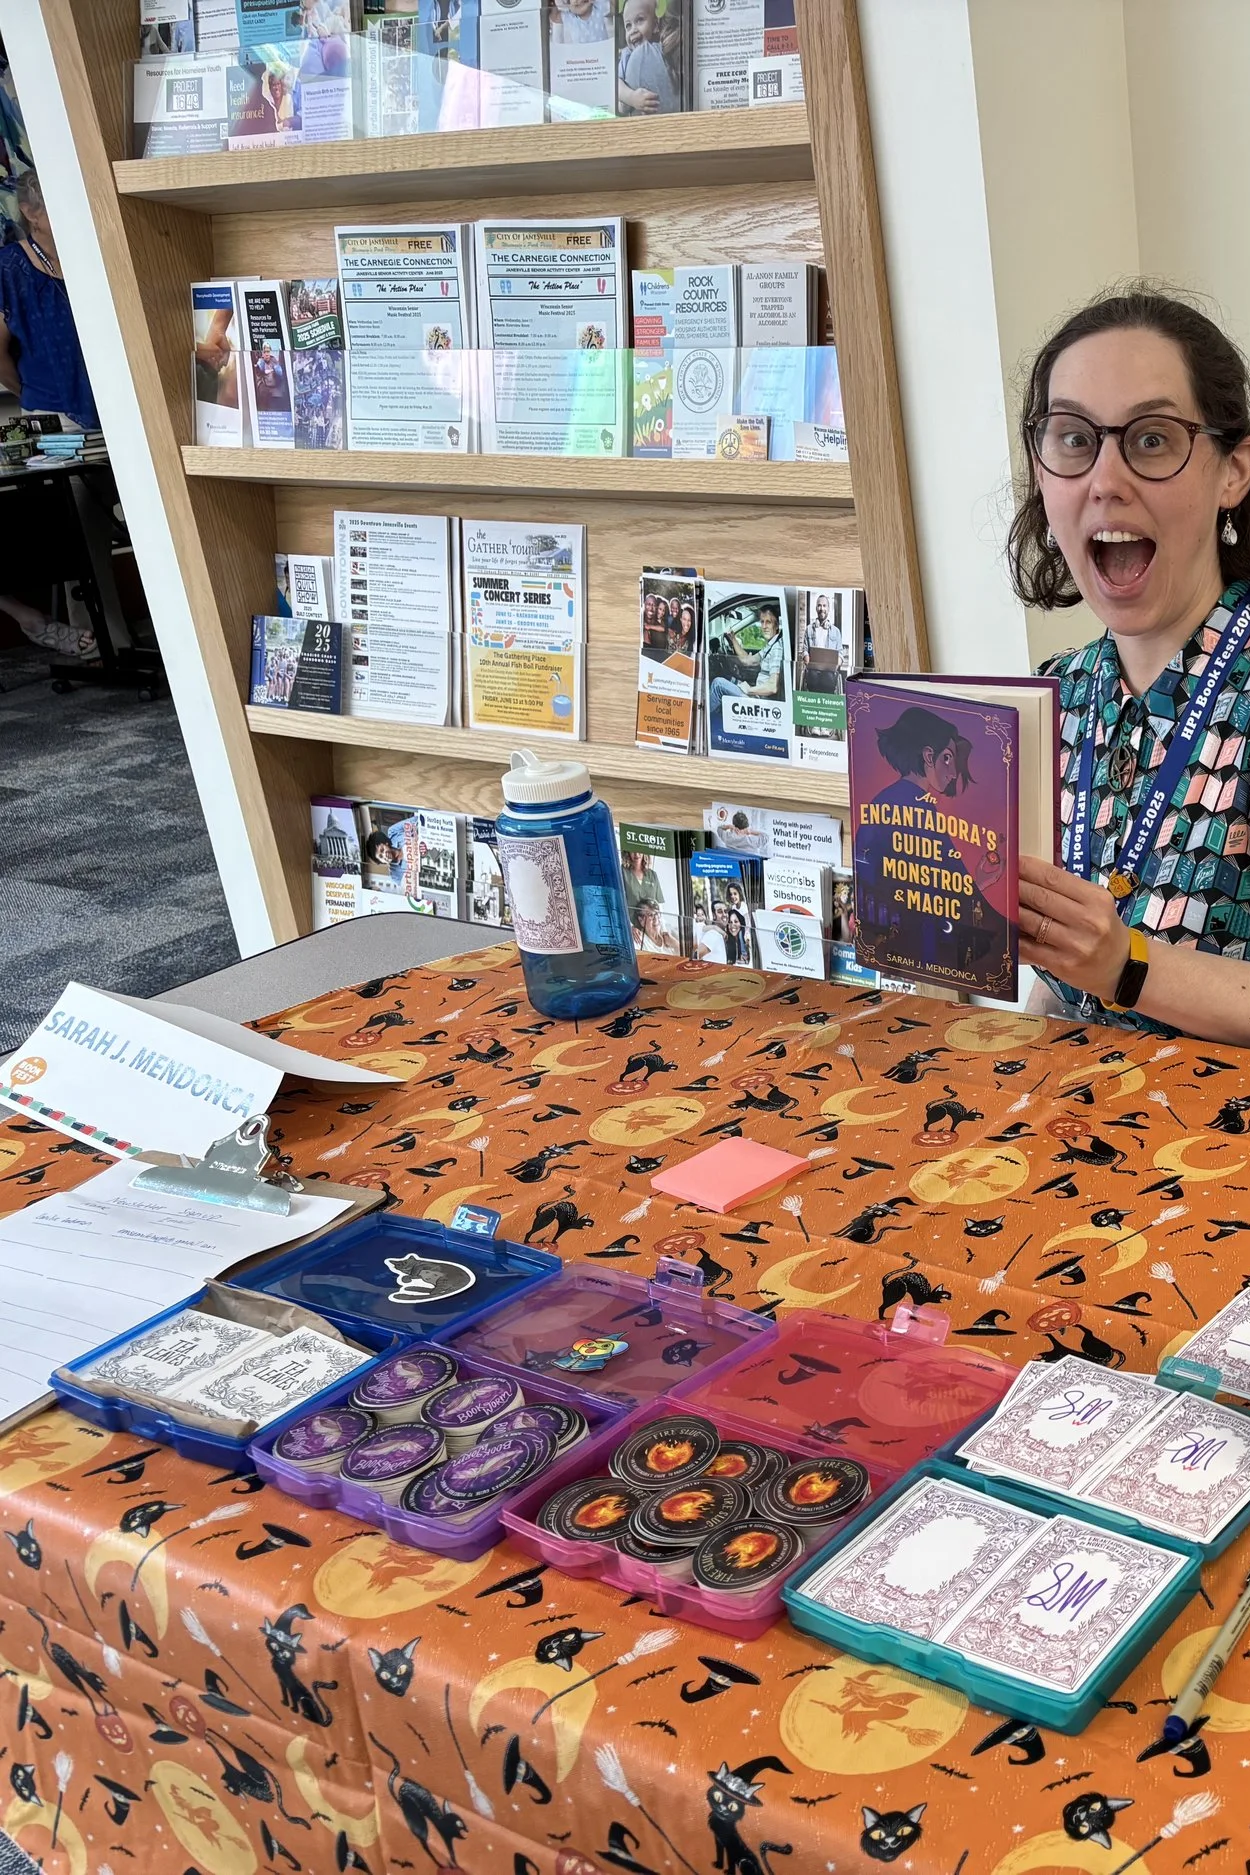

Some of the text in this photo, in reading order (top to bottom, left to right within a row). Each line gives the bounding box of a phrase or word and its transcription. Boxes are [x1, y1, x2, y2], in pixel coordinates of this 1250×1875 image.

[145, 69, 173, 77] Resources
[182, 67, 206, 75] Homeless
[173, 80, 198, 93] PROJECT
[229, 80, 245, 91] Need
[230, 93, 249, 106] health
[230, 104, 265, 120] insurance?
[408, 240, 432, 250] FREE
[566, 236, 592, 245] FREE
[344, 257, 453, 266] THE CARNEGIE CONNECTION
[491, 253, 611, 263] THE CARNEGIE CONNECTION
[688, 276, 713, 287] ROCK
[746, 272, 798, 280] AL-ANON FAMILY
[376, 284, 387, 293] The
[528, 281, 540, 290] The
[683, 289, 719, 300] COUNTY
[675, 301, 727, 313] RESOURCES
[297, 331, 310, 342] 2025
[309, 321, 335, 338] SCHEDULE
[477, 529, 486, 539] the
[468, 537, 508, 554] GATHER
[339, 534, 347, 618] DOWNTOWN
[297, 581, 315, 590] QUILT
[473, 577, 509, 590] SUMMER
[298, 592, 316, 601] SHOW
[484, 590, 551, 605] CONCERT SERIES
[315, 624, 331, 638] 20
[315, 638, 330, 652] 25
[504, 653, 531, 662] Gathering
[492, 660, 510, 668] Annual
[511, 661, 523, 669] Fish
[523, 662, 534, 670] Boil
[534, 663, 563, 672] Fundraiser
[1181, 706, 1203, 741] HPL
[1197, 670, 1220, 710] Book
[1214, 636, 1238, 674] Fest
[647, 694, 671, 706] Serving
[822, 698, 844, 706] Telework
[656, 706, 671, 715] local
[644, 715, 684, 727] communities
[1085, 705, 1096, 739] 2025
[665, 728, 680, 736] 1965
[915, 792, 938, 805] An
[773, 819, 787, 828] Living
[860, 803, 997, 851] ENCANTADORA'S
[1129, 789, 1166, 862] Fest 2025
[626, 832, 666, 845] ST. CROIX
[773, 828, 792, 838] What
[813, 835, 833, 843] could
[773, 838, 811, 851] feel better?
[892, 831, 962, 862] GUIDE to
[404, 823, 414, 897] Participating
[767, 874, 816, 888] wisconsibs
[883, 857, 974, 896] MONSTROS
[325, 882, 354, 890] WISCONSIN
[326, 891, 350, 899] DESERVES
[773, 889, 812, 904] Sibshops
[325, 899, 355, 908] PERMANENT
[894, 889, 961, 921] & MAGIC
[845, 961, 862, 972] Kids
[886, 953, 978, 983] SARAH J. MENDONCA
[18, 1061, 42, 1076] BOOK
[44, 1010, 256, 1118] SARAH J. MENDONCA
[12, 1069, 35, 1083] FEST
[169, 1339, 199, 1354] TEA
[142, 1346, 192, 1367] LEAVES
[279, 1360, 308, 1378] TEA
[253, 1366, 300, 1391] LEAVES
[456, 1390, 513, 1423] BOOK WORM
[653, 1429, 701, 1440] FIRE SLUG
[483, 1440, 512, 1458] BOOK
[352, 1459, 412, 1476] BOOK WORM
[841, 1465, 859, 1477] SLUG
[626, 1486, 647, 1499] FIRE
[706, 1493, 734, 1528] FIRE SLUG
[702, 1553, 732, 1582] FIRE SLUG
